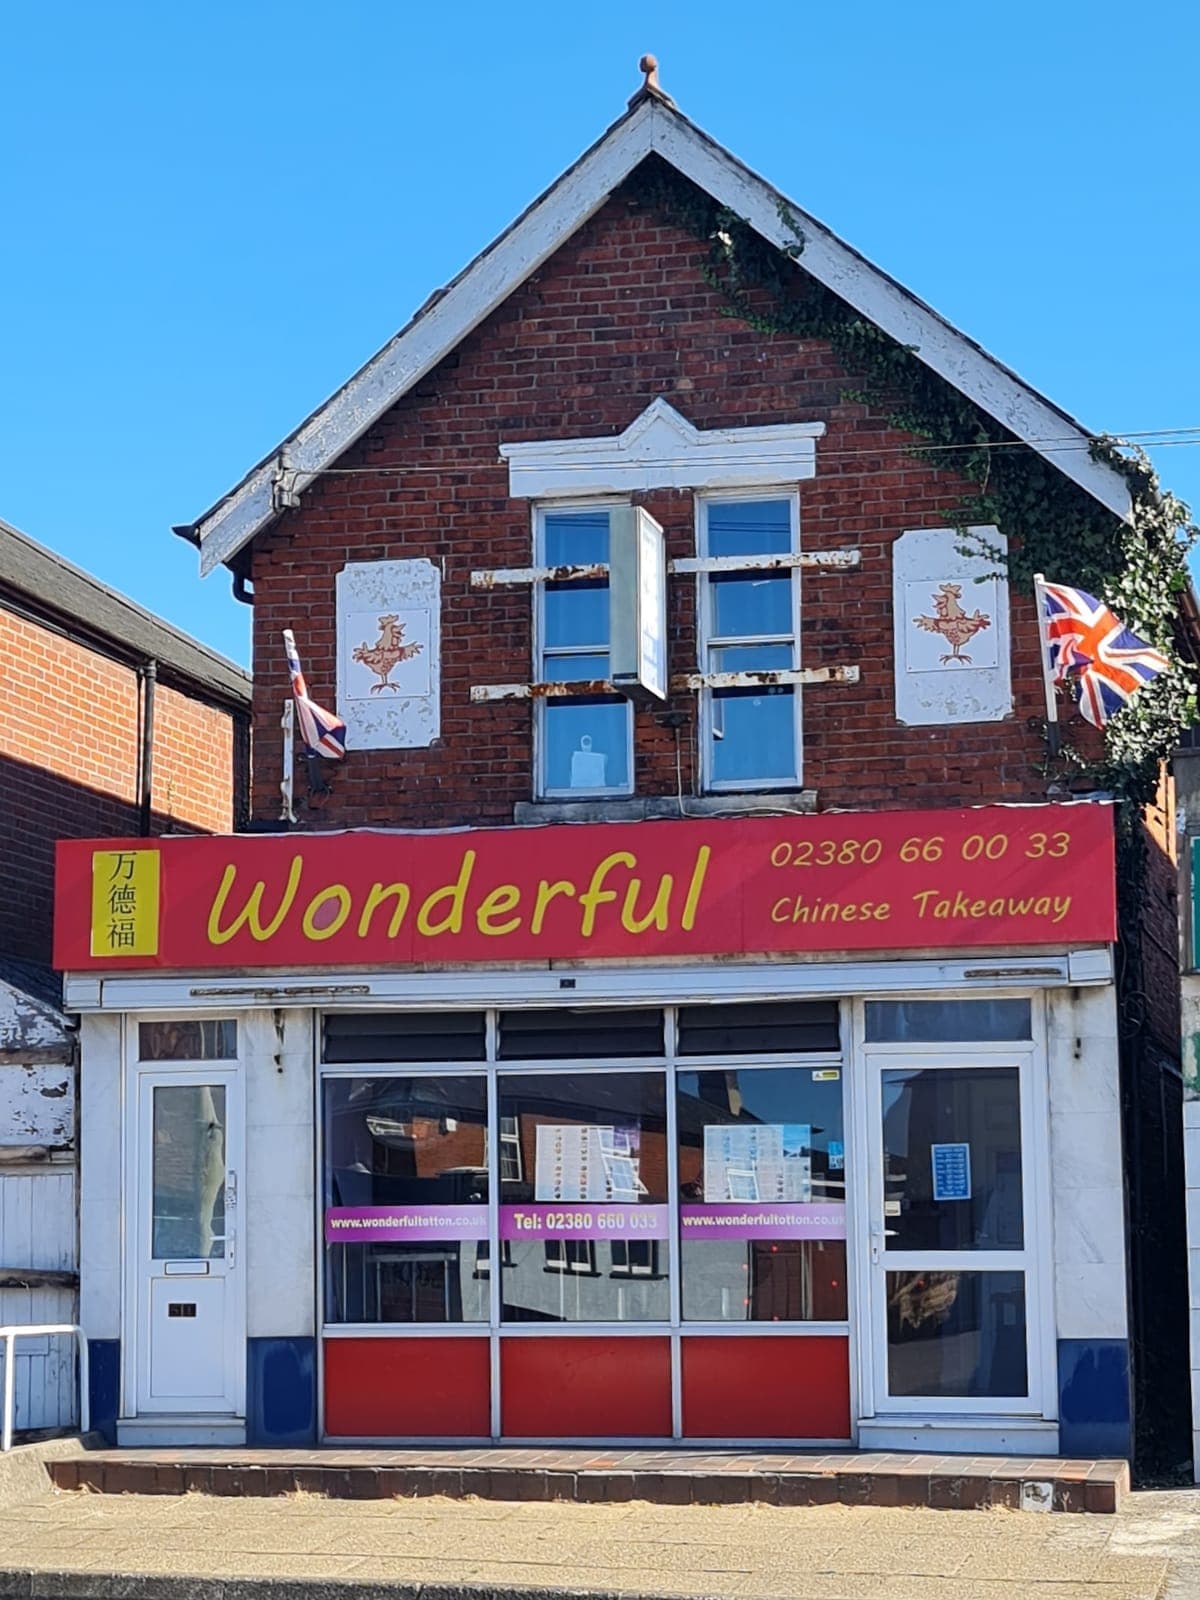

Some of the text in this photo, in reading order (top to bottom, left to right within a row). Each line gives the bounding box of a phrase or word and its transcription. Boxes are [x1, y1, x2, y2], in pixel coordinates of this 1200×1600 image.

[770, 831, 1071, 868] 02380 66 00 33
[106, 851, 137, 949] 万德福
[207, 844, 711, 945] Wonderful
[770, 889, 1072, 923] Chinese Takeaway
[513, 1212, 658, 1230] Tel: 02380 660 033
